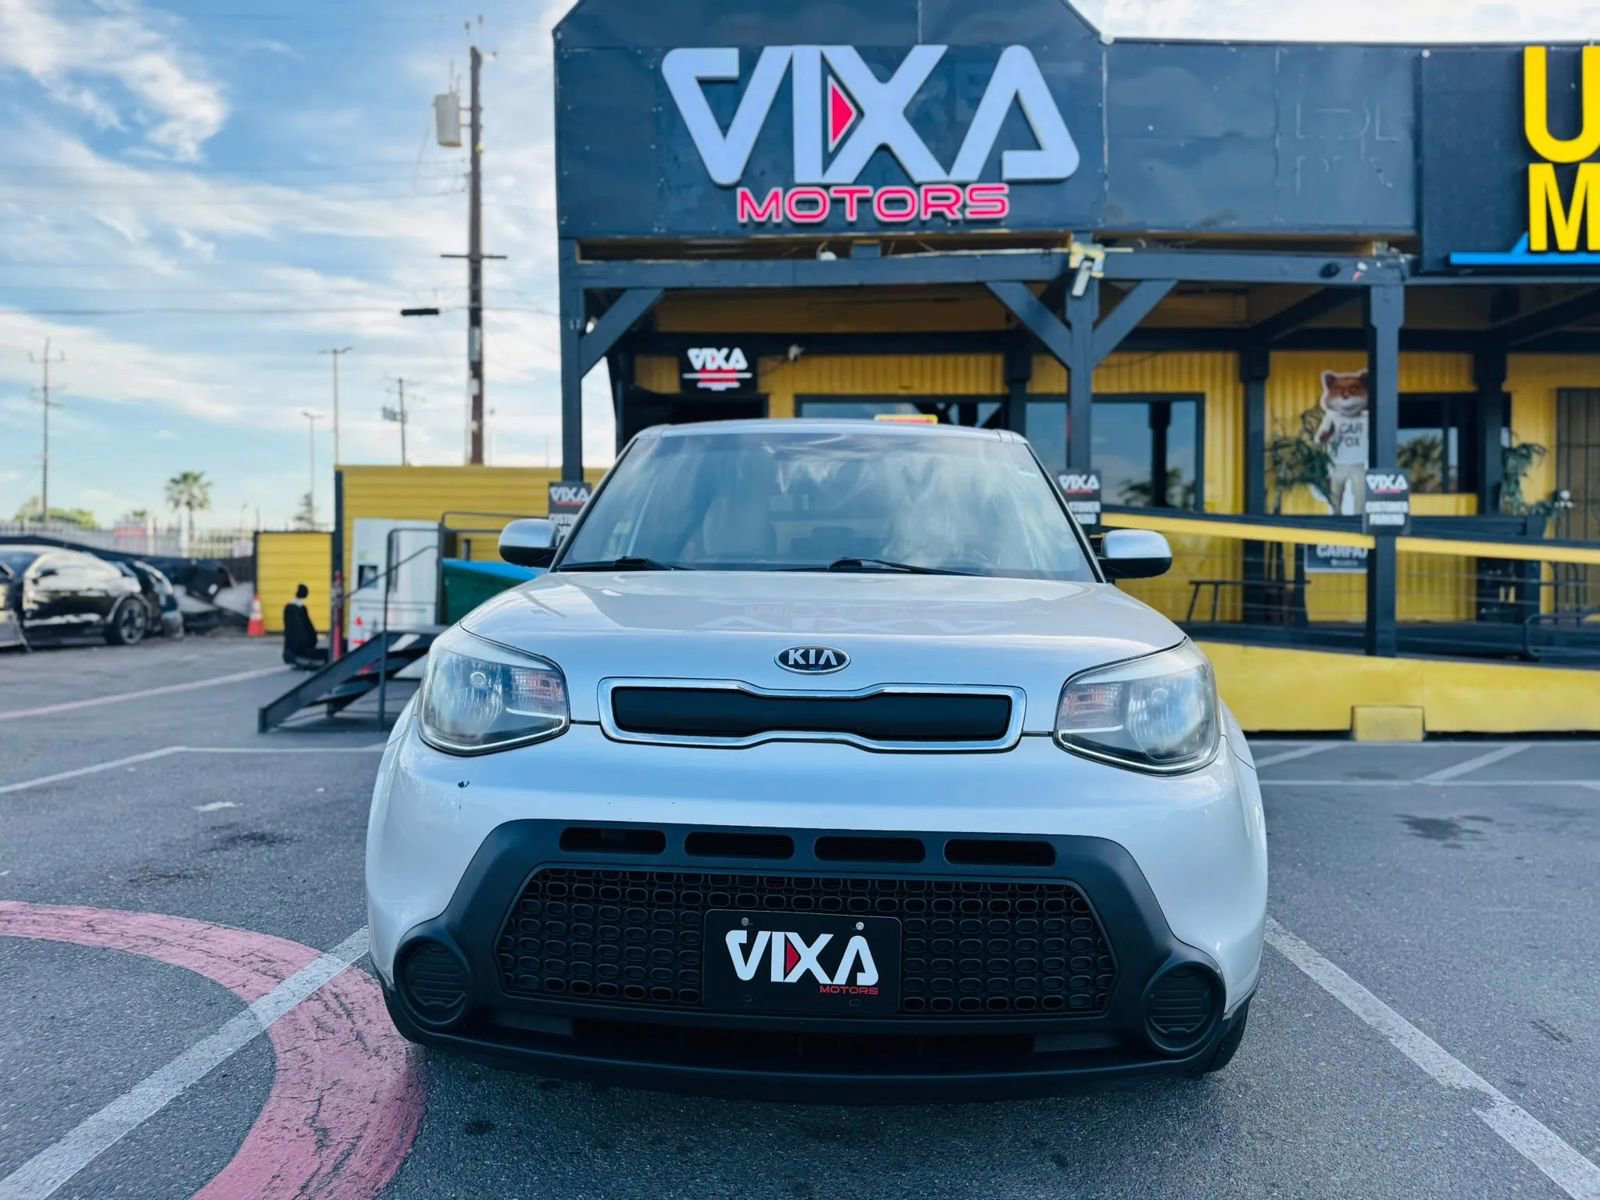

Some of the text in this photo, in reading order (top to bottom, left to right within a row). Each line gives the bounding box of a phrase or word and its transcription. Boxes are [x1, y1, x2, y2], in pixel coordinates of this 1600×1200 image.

[662, 44, 1080, 186] VIXA
[736, 183, 1010, 224] MOTORS
[686, 347, 749, 371] VIXA
[1338, 422, 1363, 435] CAR
[1058, 474, 1100, 490] VIXA
[1366, 474, 1409, 491] VIXA
[787, 648, 838, 666] KIA
[725, 929, 879, 986] VIXA
[819, 985, 879, 996] MOTORS
